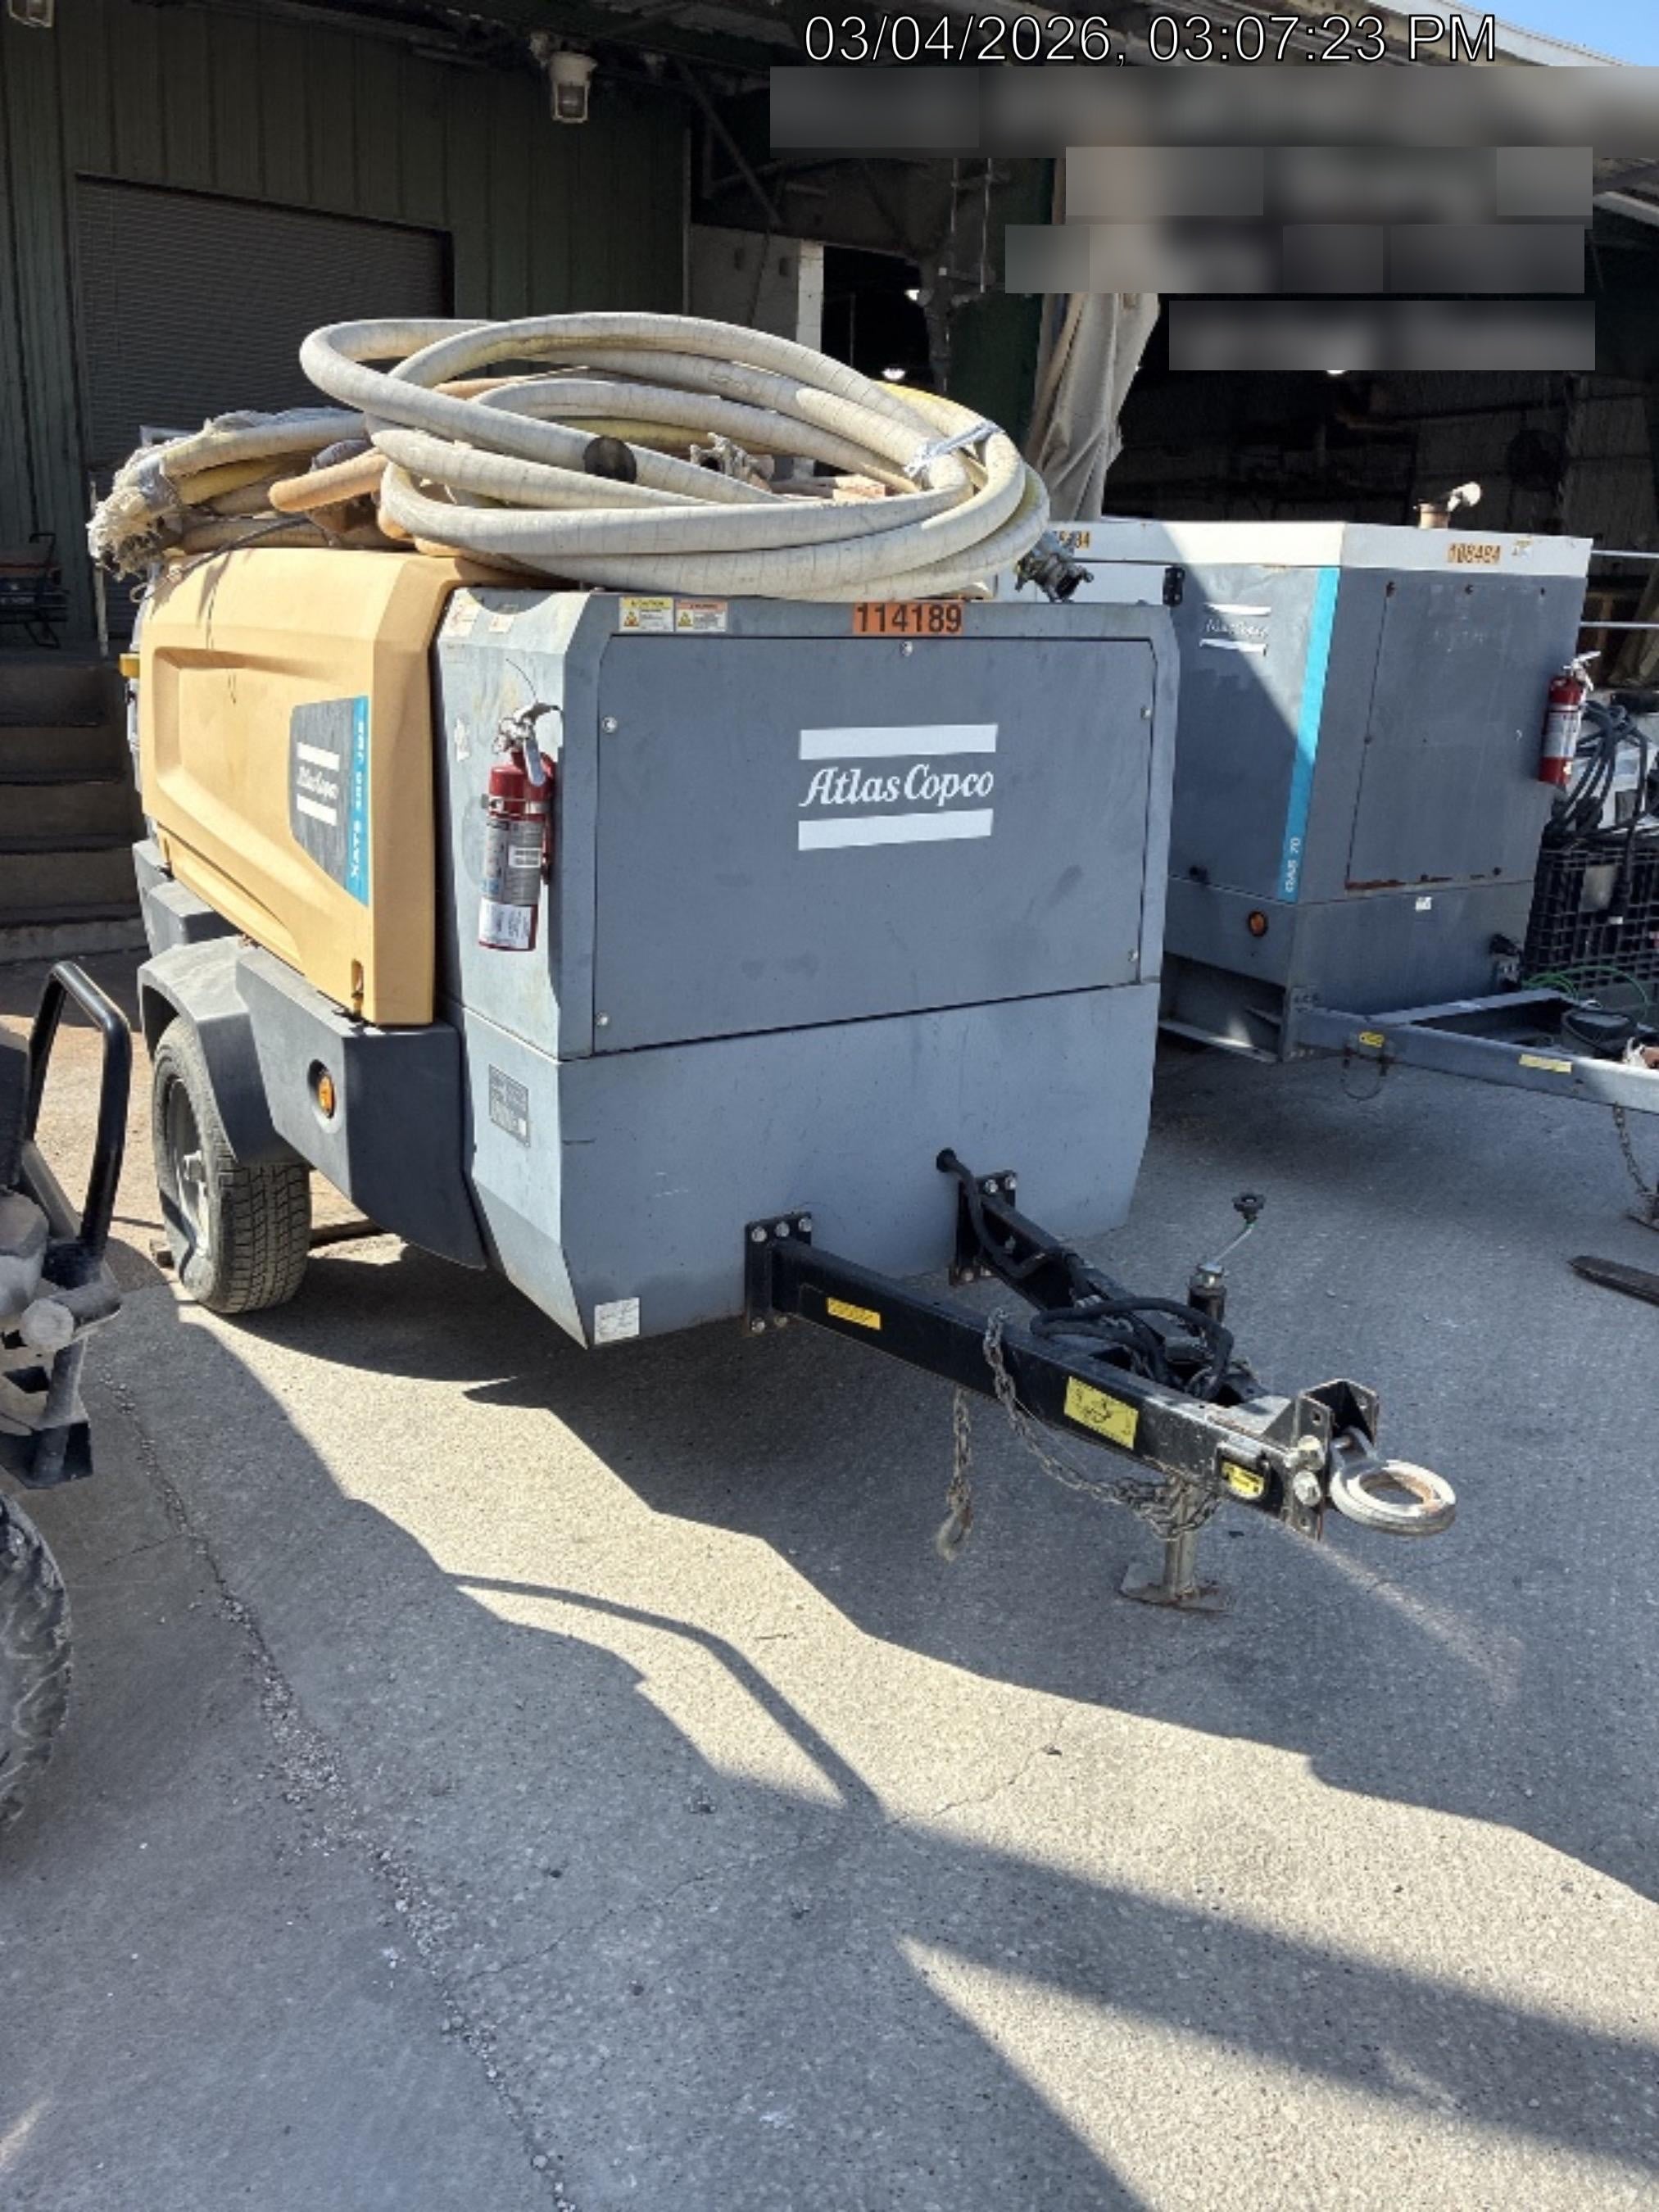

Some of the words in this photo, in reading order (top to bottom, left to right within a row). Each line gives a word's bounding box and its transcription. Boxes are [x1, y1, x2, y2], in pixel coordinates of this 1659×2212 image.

[856, 601, 963, 632] 114189
[798, 766, 900, 807] Atlas
[903, 764, 995, 807] Copco
[1290, 836, 1302, 854] 70
